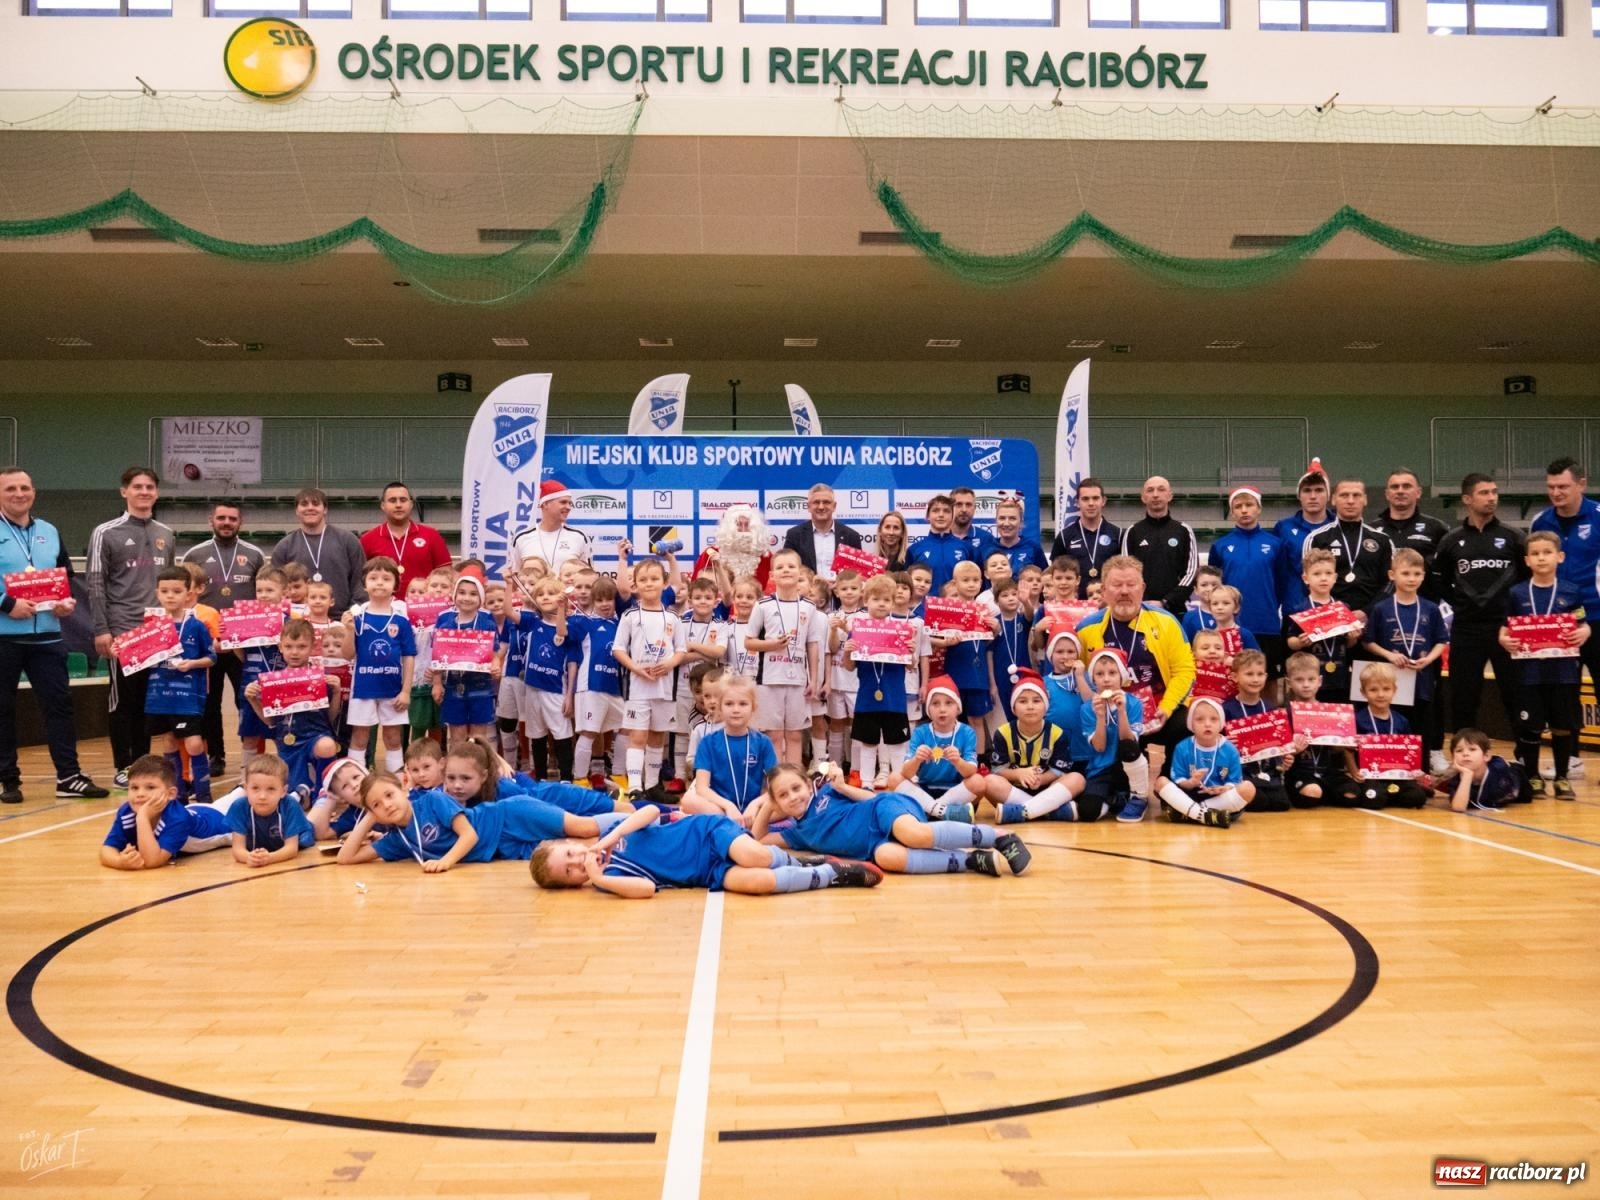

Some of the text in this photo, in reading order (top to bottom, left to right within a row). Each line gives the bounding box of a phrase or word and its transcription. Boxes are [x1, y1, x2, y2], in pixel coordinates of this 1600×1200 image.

[338, 35, 1209, 89] OŚRODEK SPORTU I REKREACJI RACIBÓRZ
[1001, 379, 1013, 390] C
[1020, 380, 1029, 390] C
[1509, 381, 1525, 392] D
[651, 405, 675, 419] UNIA
[173, 420, 251, 435] MIESZKO
[495, 429, 532, 452] UNIA
[566, 442, 952, 466] MIEJSKI KLUB SPORTOWY UNIA RACIBÓRZ
[973, 454, 998, 471] UNIA
[470, 480, 481, 549] SPORTOWY
[1471, 559, 1511, 569] SPORT
